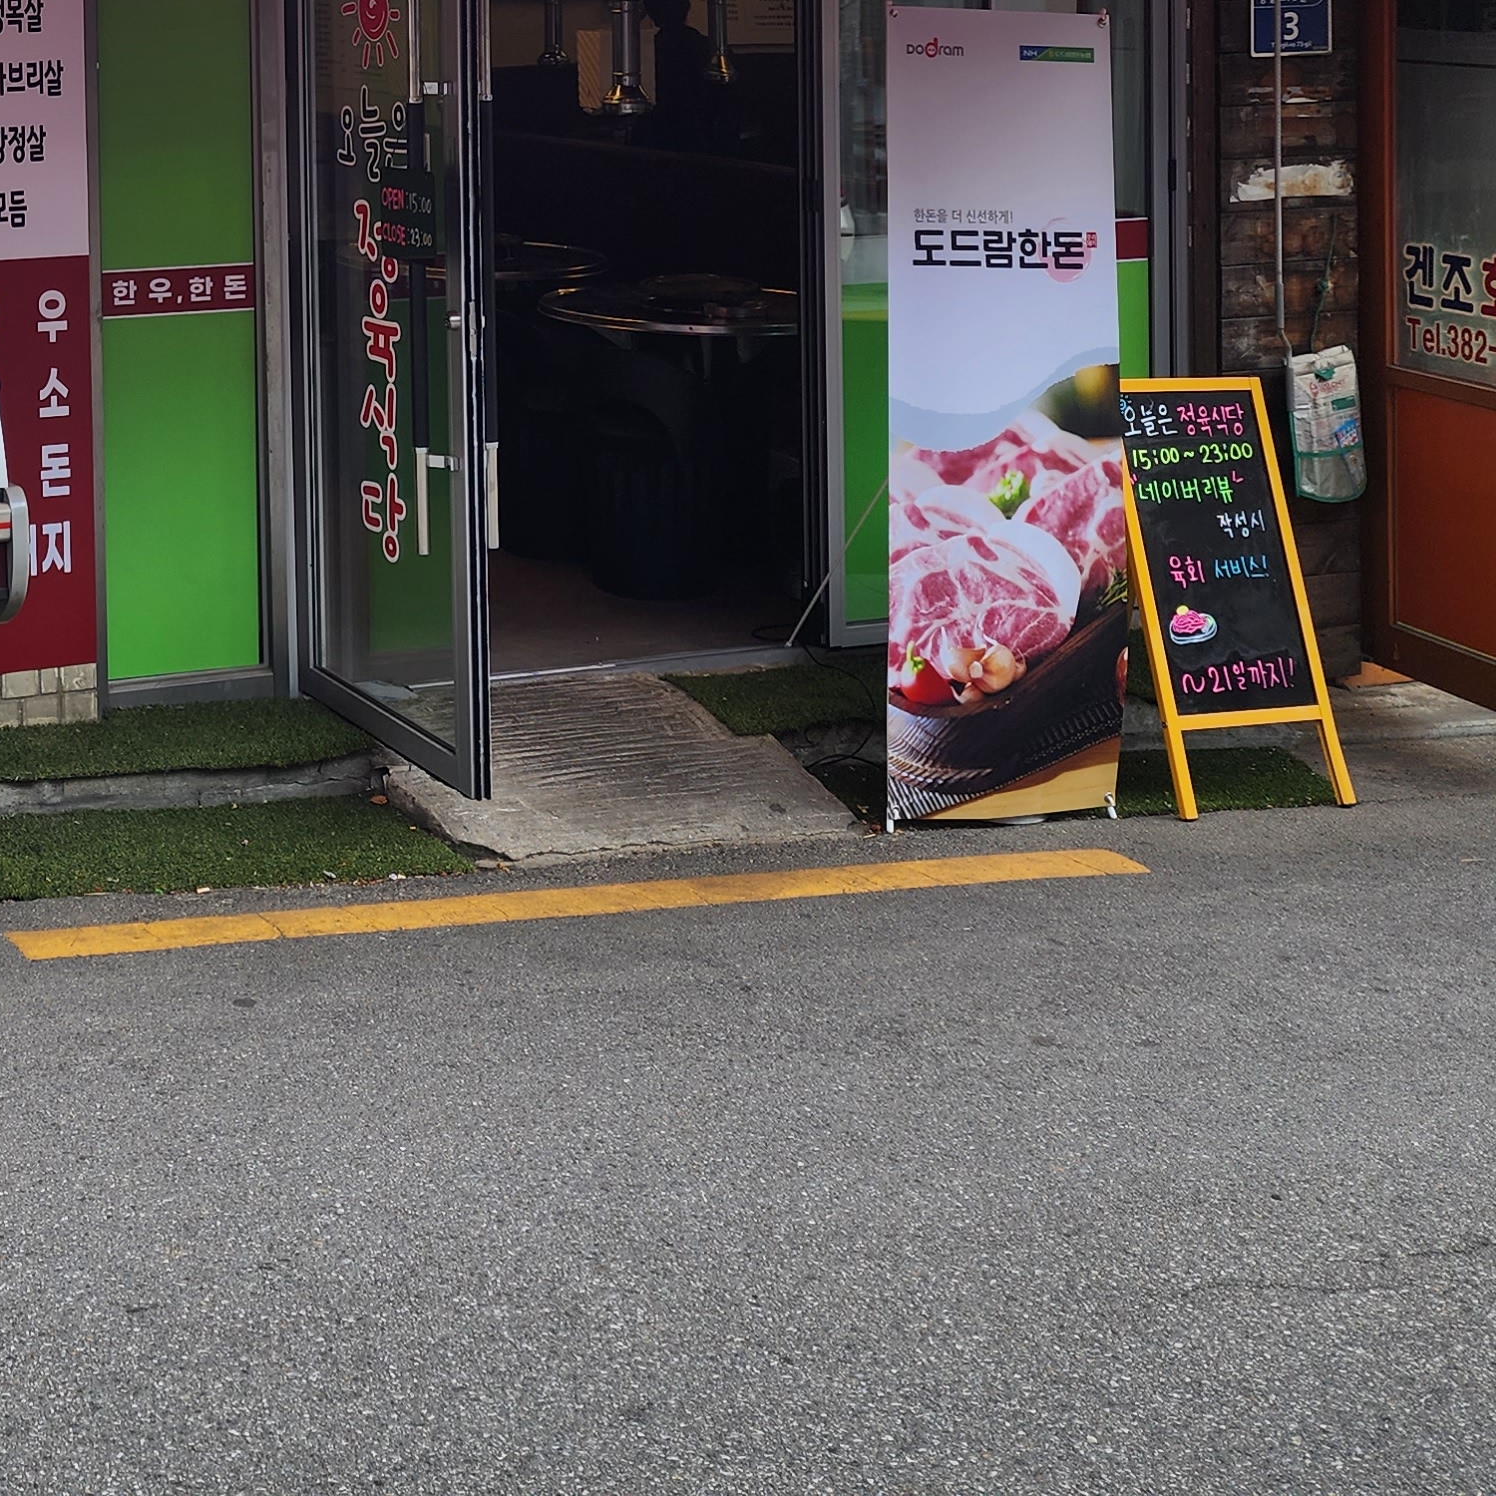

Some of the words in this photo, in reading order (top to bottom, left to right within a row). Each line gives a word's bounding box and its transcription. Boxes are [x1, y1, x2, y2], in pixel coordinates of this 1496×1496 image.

[1284, 11, 1299, 40] 3
[913, 208, 948, 223] 한돈을
[952, 209, 962, 223] 더
[965, 208, 1013, 224] 신선하게!
[912, 229, 1084, 270] 도드람한돈
[1124, 404, 1178, 437] 오늘은
[1177, 402, 1245, 437] 정육식당
[1216, 509, 1266, 539] 작성시
[1169, 556, 1206, 589] 육회
[1214, 555, 1269, 579] 서비스!
